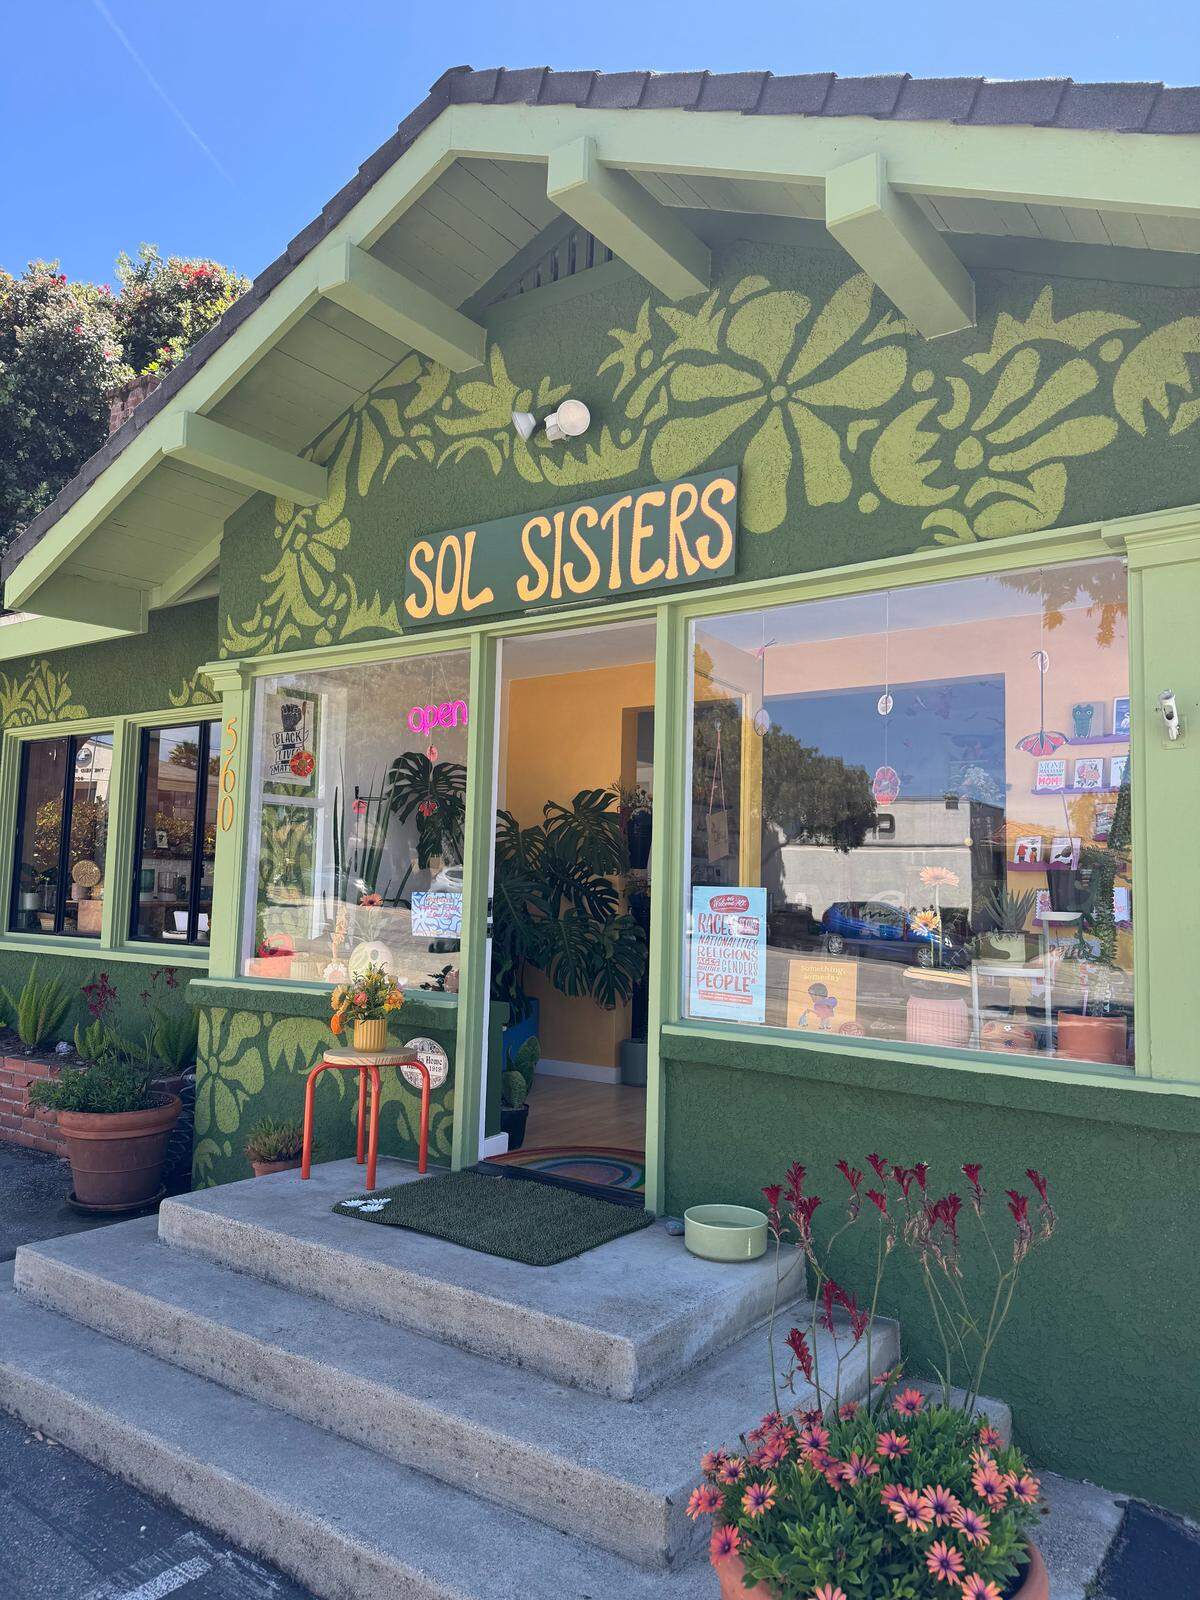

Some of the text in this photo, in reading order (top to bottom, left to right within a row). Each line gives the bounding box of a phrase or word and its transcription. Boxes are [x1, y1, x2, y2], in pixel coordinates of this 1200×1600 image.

[404, 478, 737, 619] SOL SISTERS
[407, 699, 468, 737] open
[275, 731, 302, 745] BLACK
[216, 717, 238, 833] 560
[699, 934, 759, 951] NATIONALITIES
[697, 945, 759, 963] RELIGIONS
[721, 959, 759, 977] GENDERS
